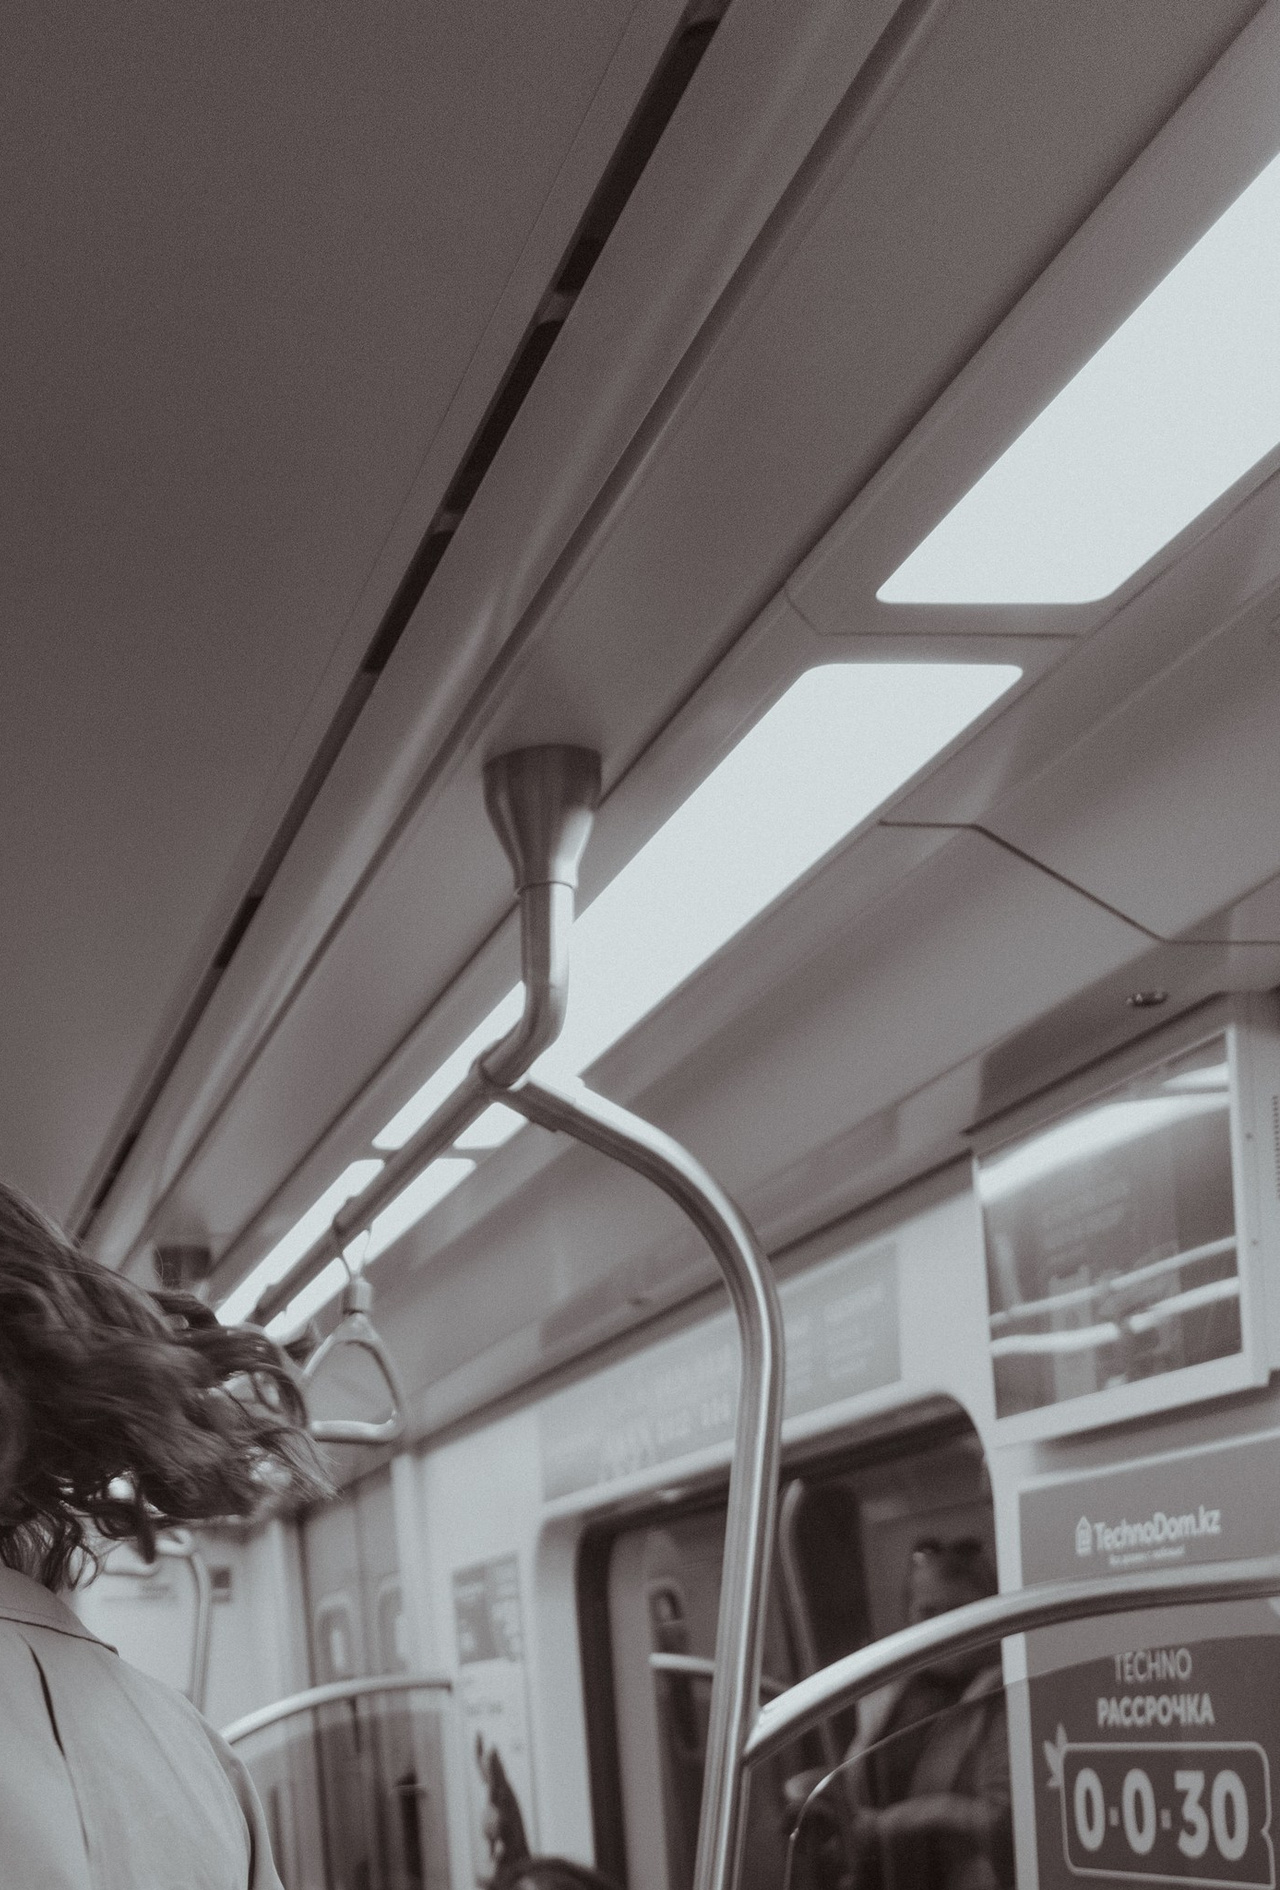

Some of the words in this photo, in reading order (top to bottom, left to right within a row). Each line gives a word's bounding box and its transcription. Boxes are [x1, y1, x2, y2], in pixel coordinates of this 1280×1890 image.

[1093, 1504, 1221, 1550] TechnoDom.kz
[1114, 1648, 1193, 1684] TECHNO
[1097, 1693, 1216, 1727] РАССРОЧКА
